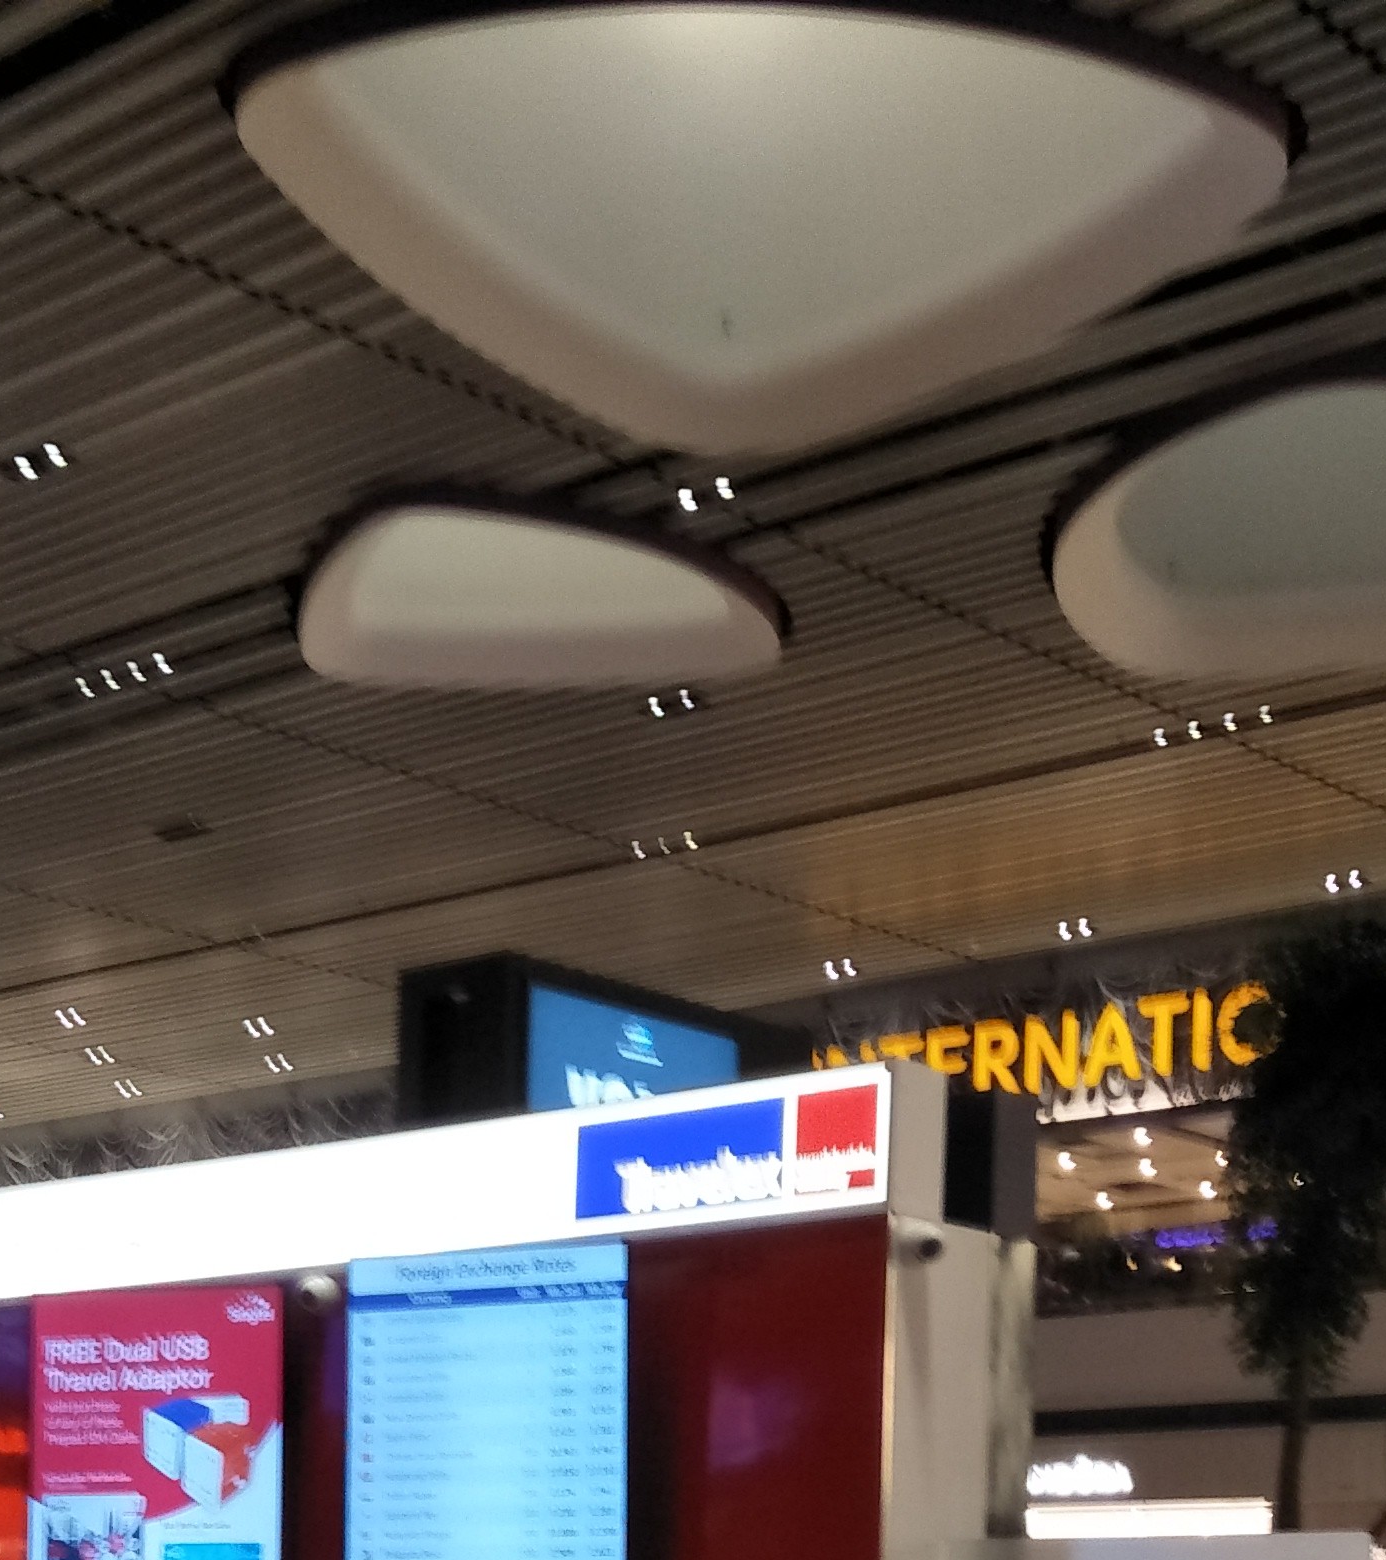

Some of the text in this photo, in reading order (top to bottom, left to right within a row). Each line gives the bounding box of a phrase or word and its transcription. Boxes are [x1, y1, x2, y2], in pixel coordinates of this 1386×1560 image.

[41, 1331, 210, 1365] FREE Dual USB
[41, 1363, 214, 1395] Travel Adaptor
